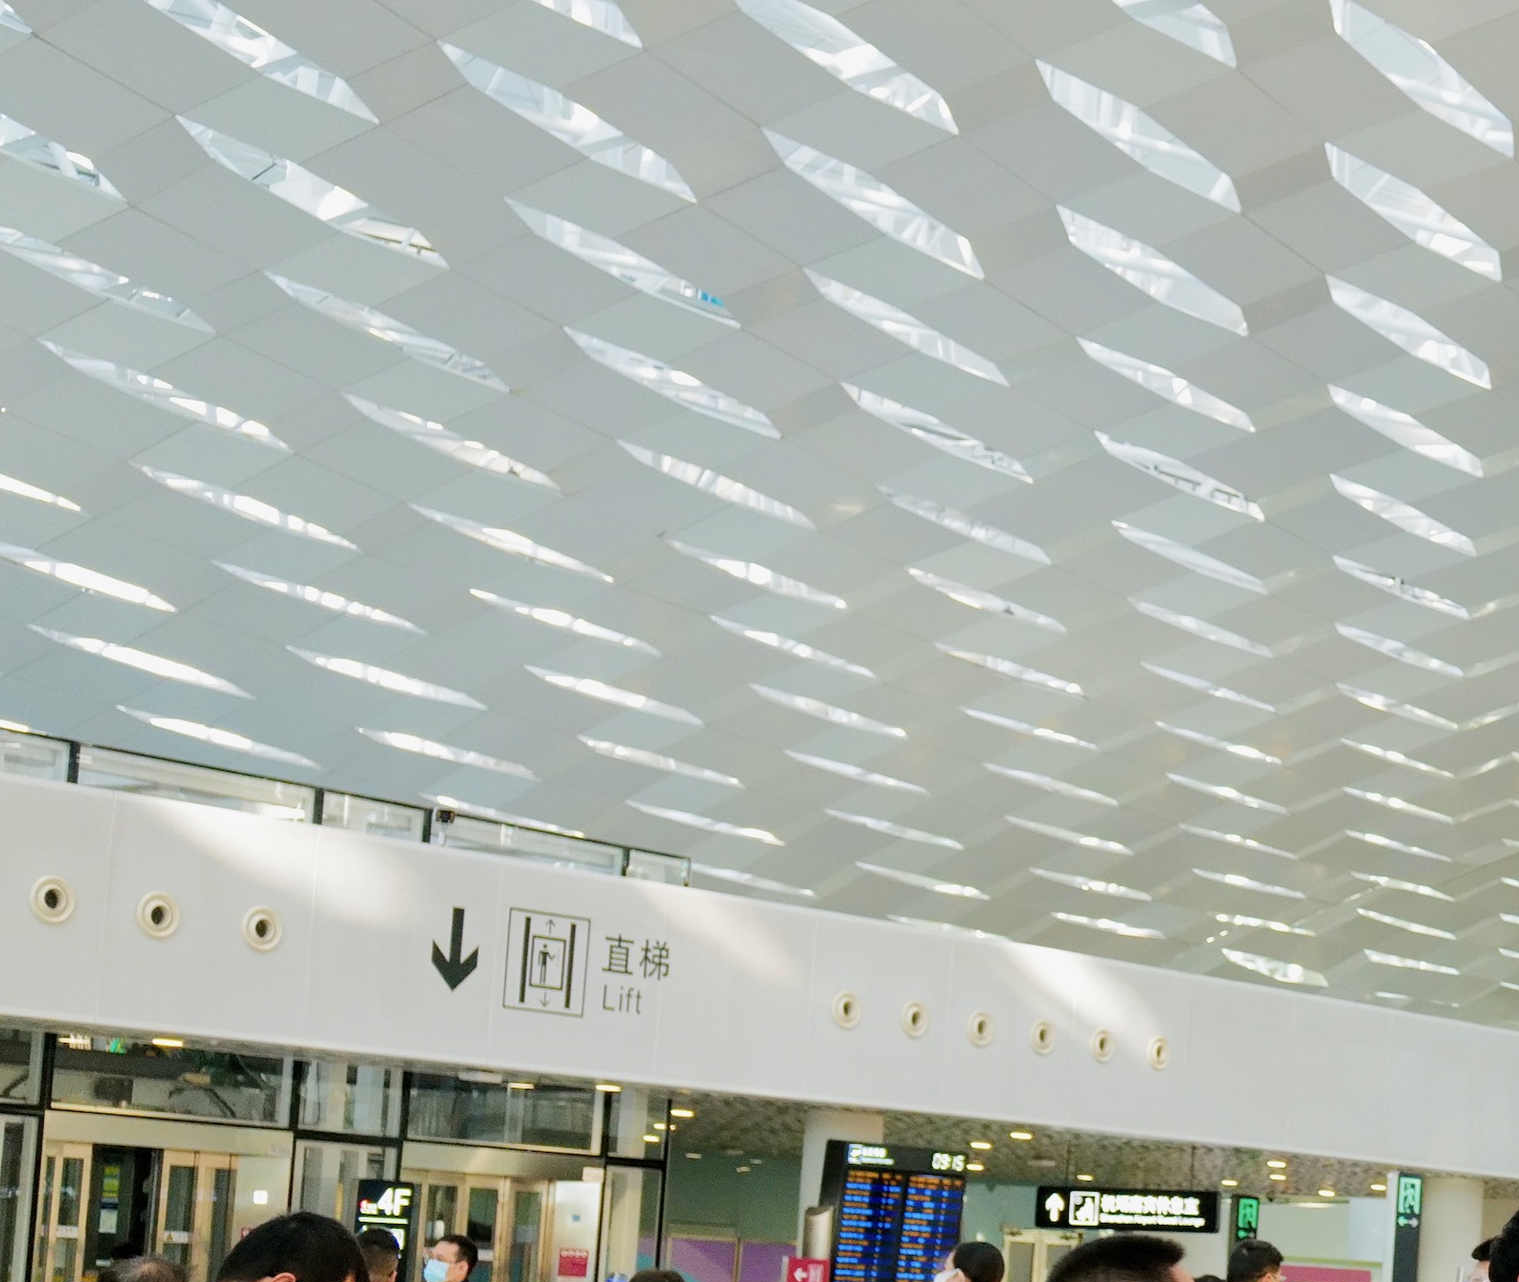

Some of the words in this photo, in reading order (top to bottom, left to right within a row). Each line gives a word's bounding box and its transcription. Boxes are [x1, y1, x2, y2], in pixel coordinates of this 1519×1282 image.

[601, 933, 670, 981] 直梯
[602, 984, 641, 1015] Lift
[378, 1187, 412, 1216] 4F
